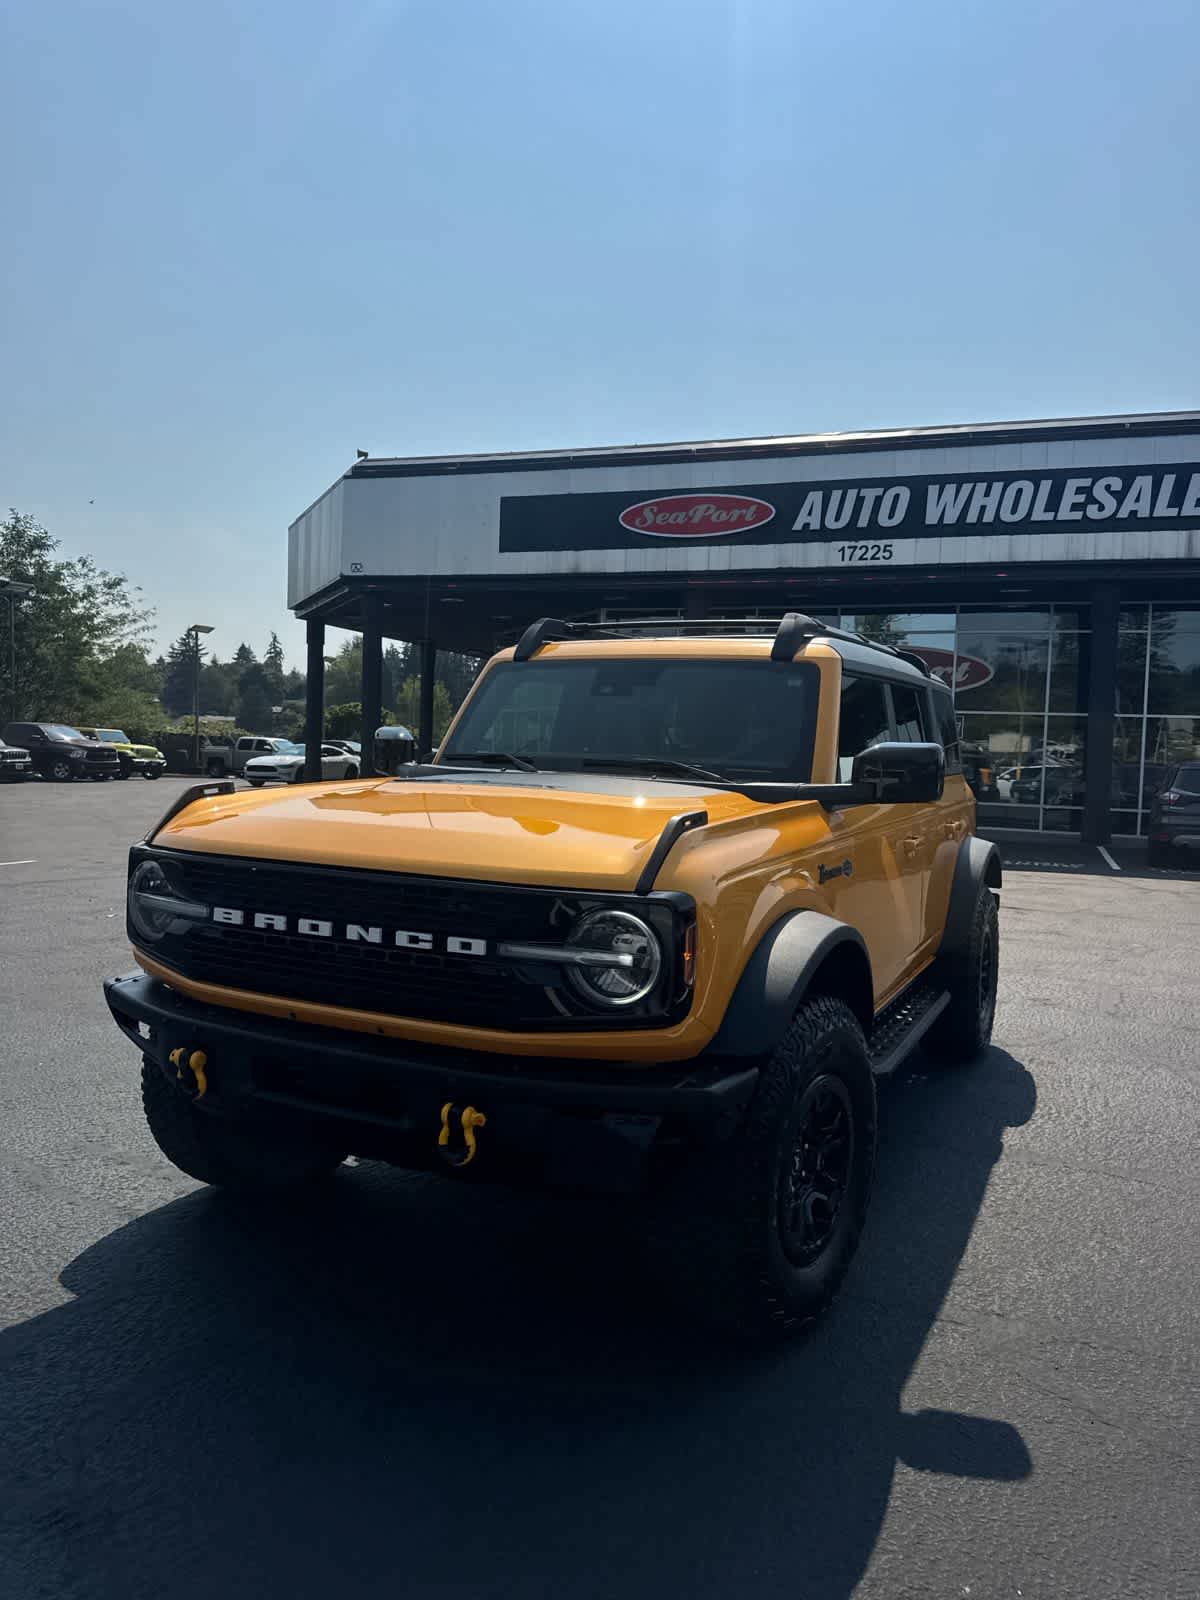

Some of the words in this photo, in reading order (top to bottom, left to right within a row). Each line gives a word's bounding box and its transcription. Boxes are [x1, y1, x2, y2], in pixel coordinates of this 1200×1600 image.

[635, 504, 758, 527] SeaPort
[792, 486, 911, 531] AUTO
[838, 544, 893, 562] 17225
[213, 907, 487, 956] BRONCO
